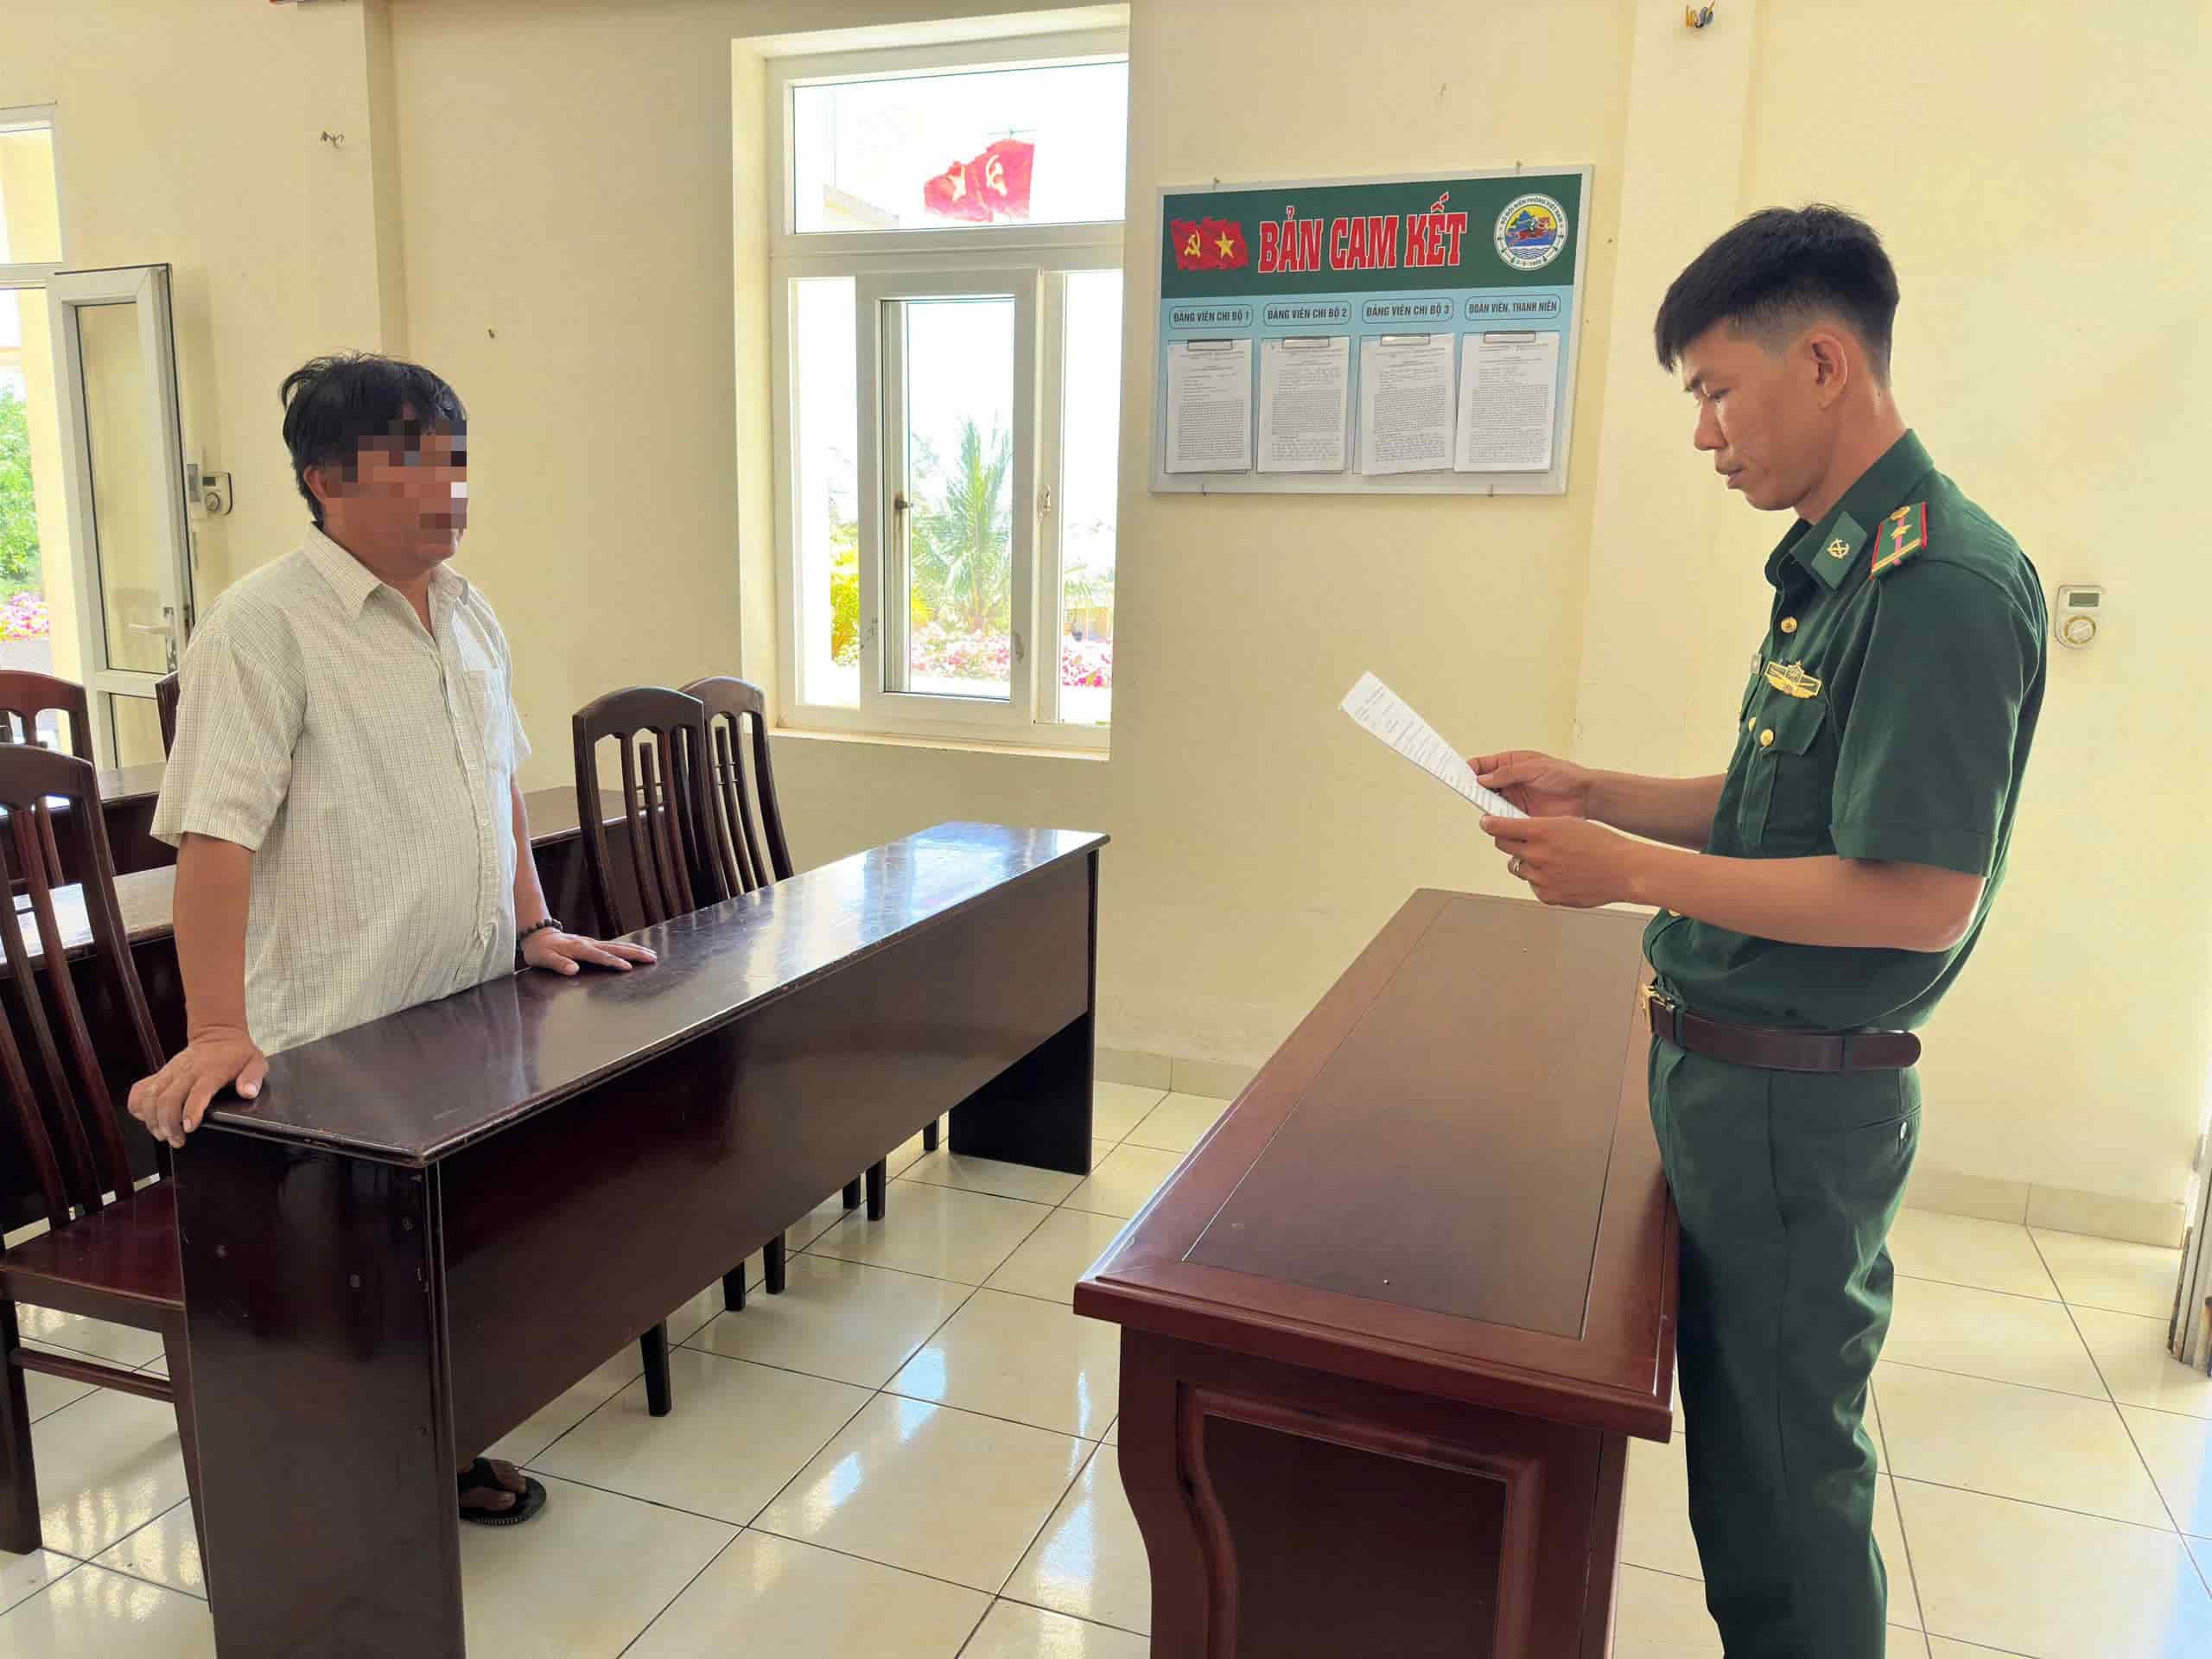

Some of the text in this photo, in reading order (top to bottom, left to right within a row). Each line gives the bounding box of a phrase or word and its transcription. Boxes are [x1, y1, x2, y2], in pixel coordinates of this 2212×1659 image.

[1258, 205, 1324, 273] BẢN
[1329, 215, 1400, 270] CAM
[1404, 191, 1468, 268] KẾT
[1313, 308, 1326, 318] CHI
[1342, 308, 1348, 318] 2
[1413, 305, 1427, 315] CHI
[1444, 304, 1450, 315] 3
[1217, 311, 1230, 321] CHI
